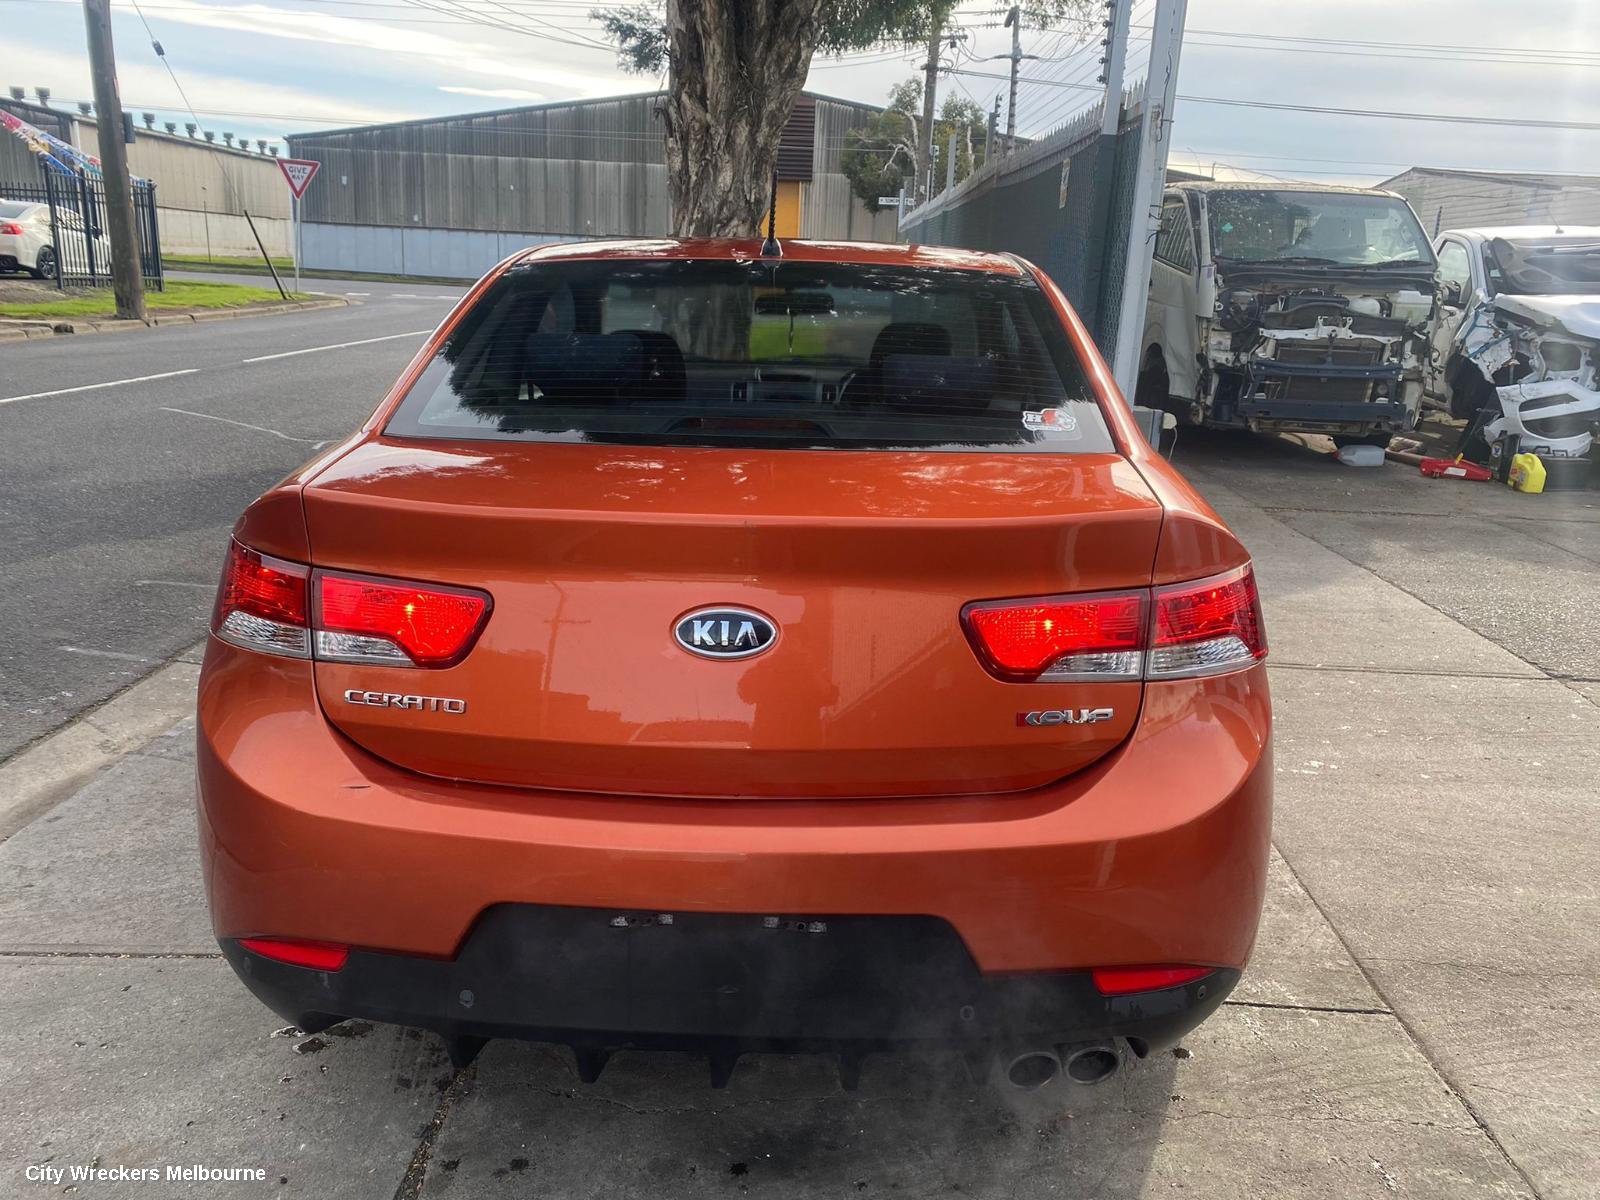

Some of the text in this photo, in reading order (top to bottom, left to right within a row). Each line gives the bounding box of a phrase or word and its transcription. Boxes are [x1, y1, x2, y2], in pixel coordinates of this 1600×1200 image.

[289, 166, 308, 175] GIVE
[692, 620, 760, 646] KIA
[344, 690, 465, 713] CERATO
